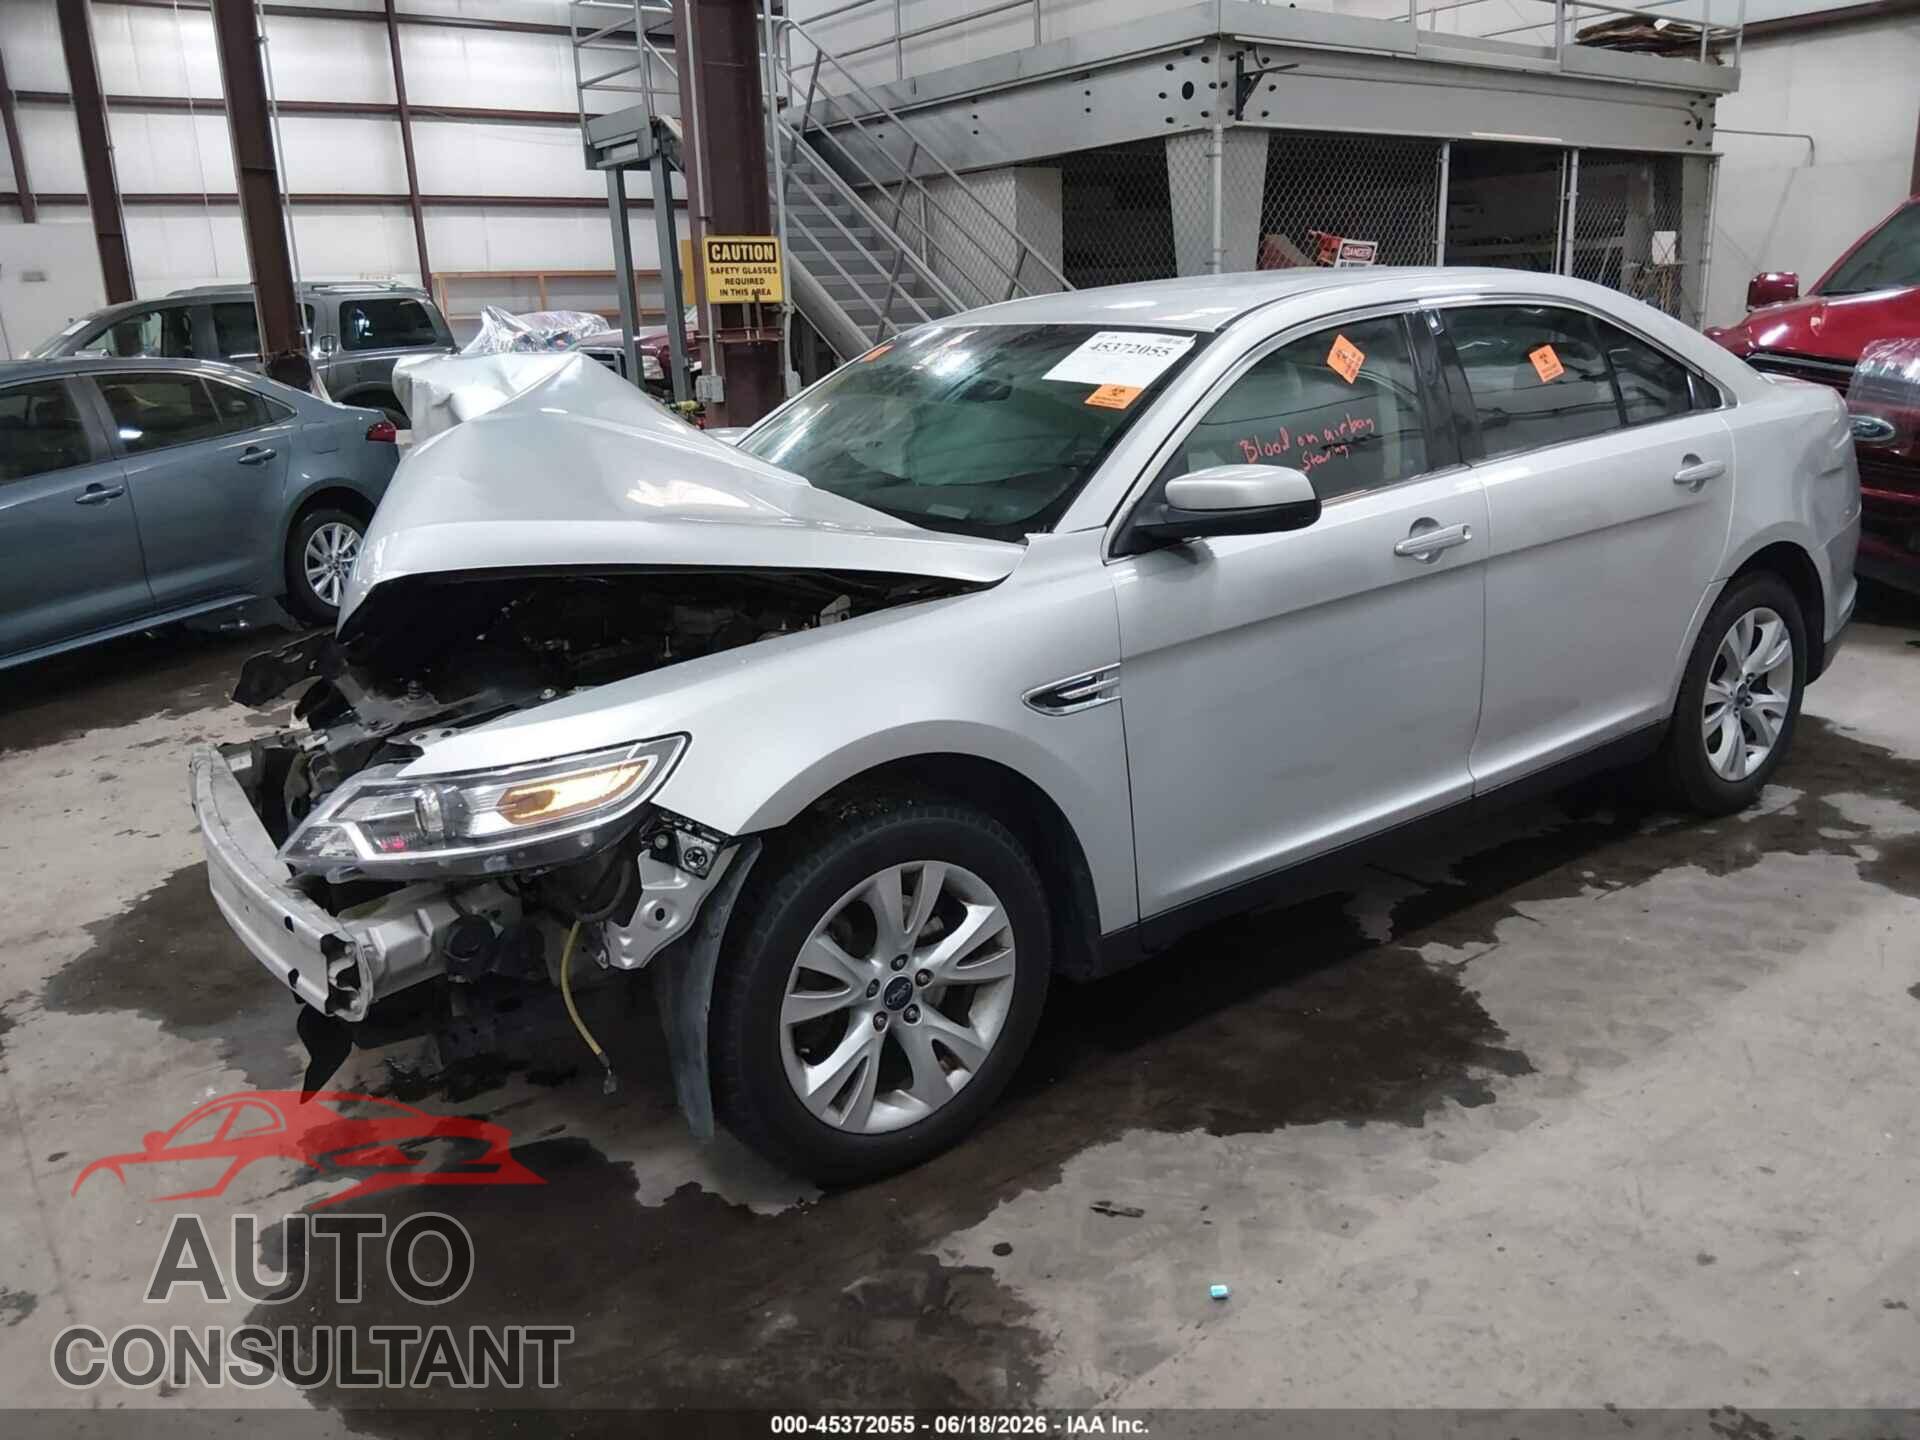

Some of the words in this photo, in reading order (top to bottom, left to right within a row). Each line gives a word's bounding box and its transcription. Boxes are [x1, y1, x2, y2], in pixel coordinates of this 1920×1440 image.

[711, 244, 774, 261] CAUTION
[1343, 246, 1372, 257] DANGER
[710, 267, 740, 275] SAFETY
[742, 266, 777, 275] GLASSES
[720, 288, 728, 296] IN
[730, 288, 749, 296] THIS
[751, 288, 772, 296] AREA
[1239, 426, 1290, 464] Blood
[1297, 433, 1318, 447] on
